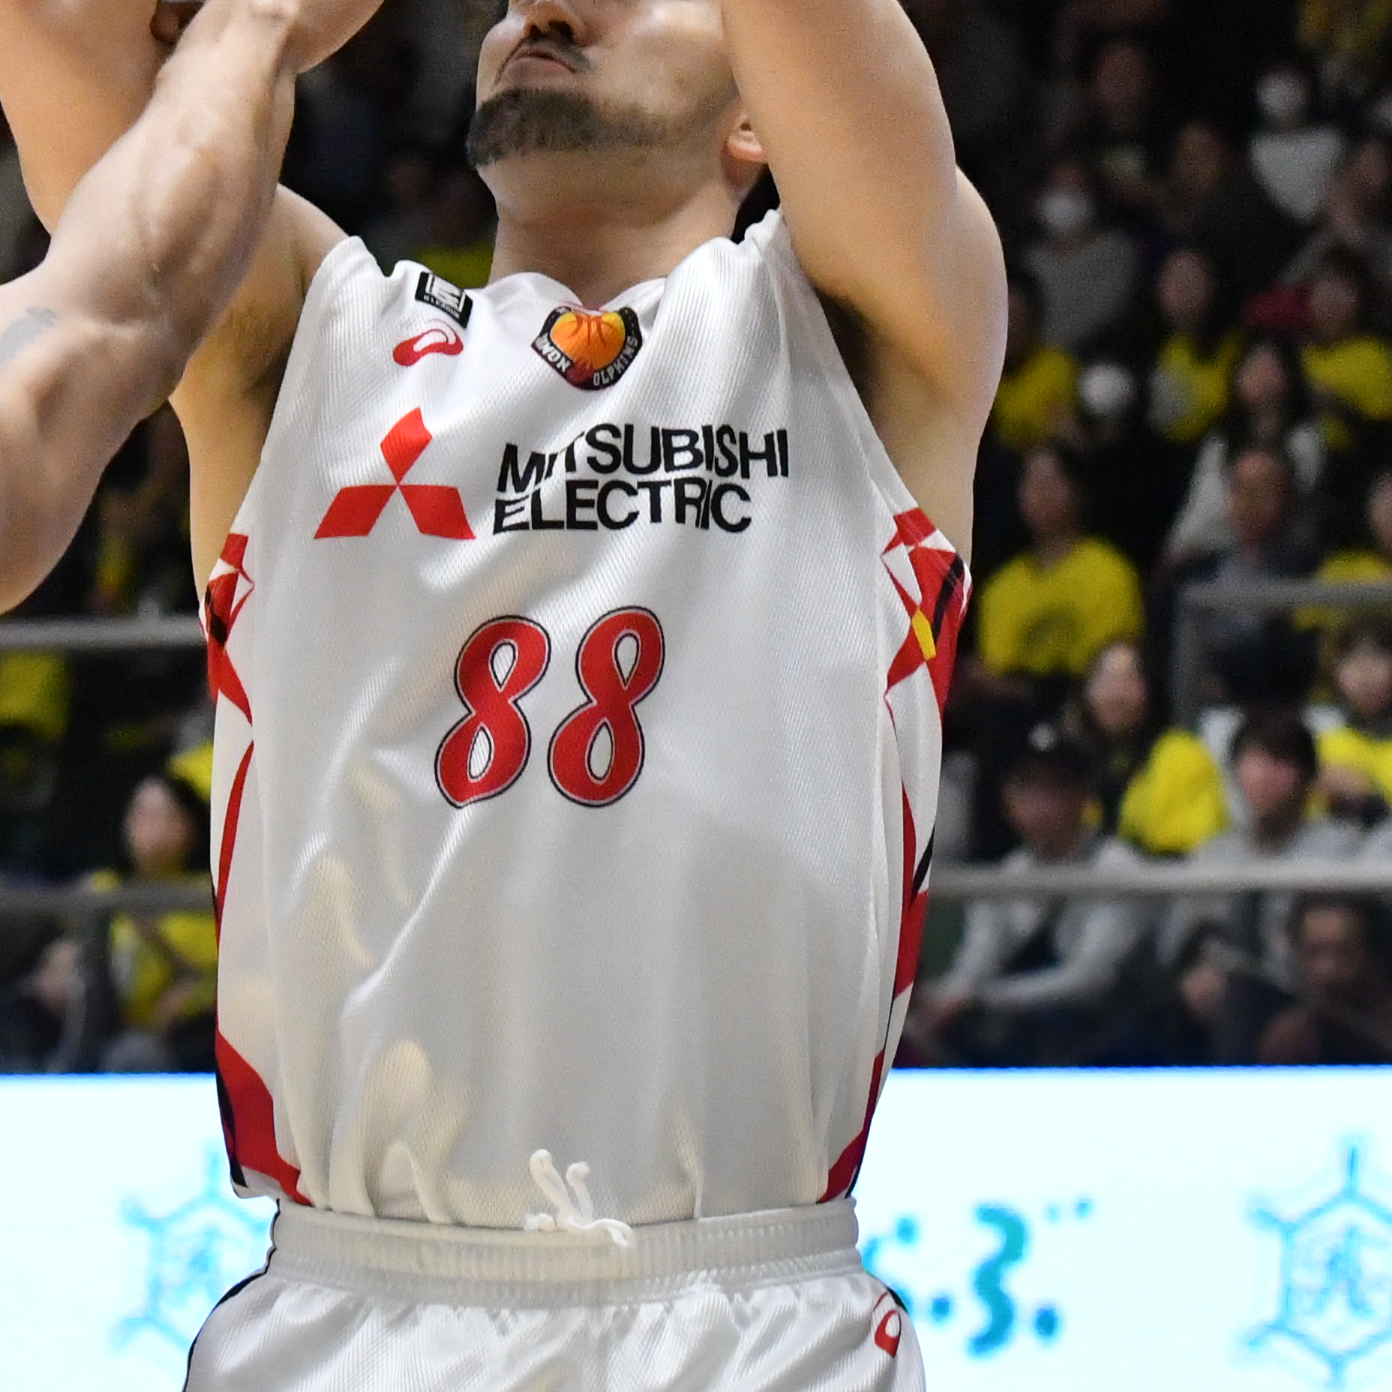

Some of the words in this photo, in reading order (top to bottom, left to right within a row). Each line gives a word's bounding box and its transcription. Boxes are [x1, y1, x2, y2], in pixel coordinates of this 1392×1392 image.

[497, 423, 789, 493] MITSUBISHI
[493, 477, 752, 534] ELECTRIC
[434, 606, 666, 809] 88
